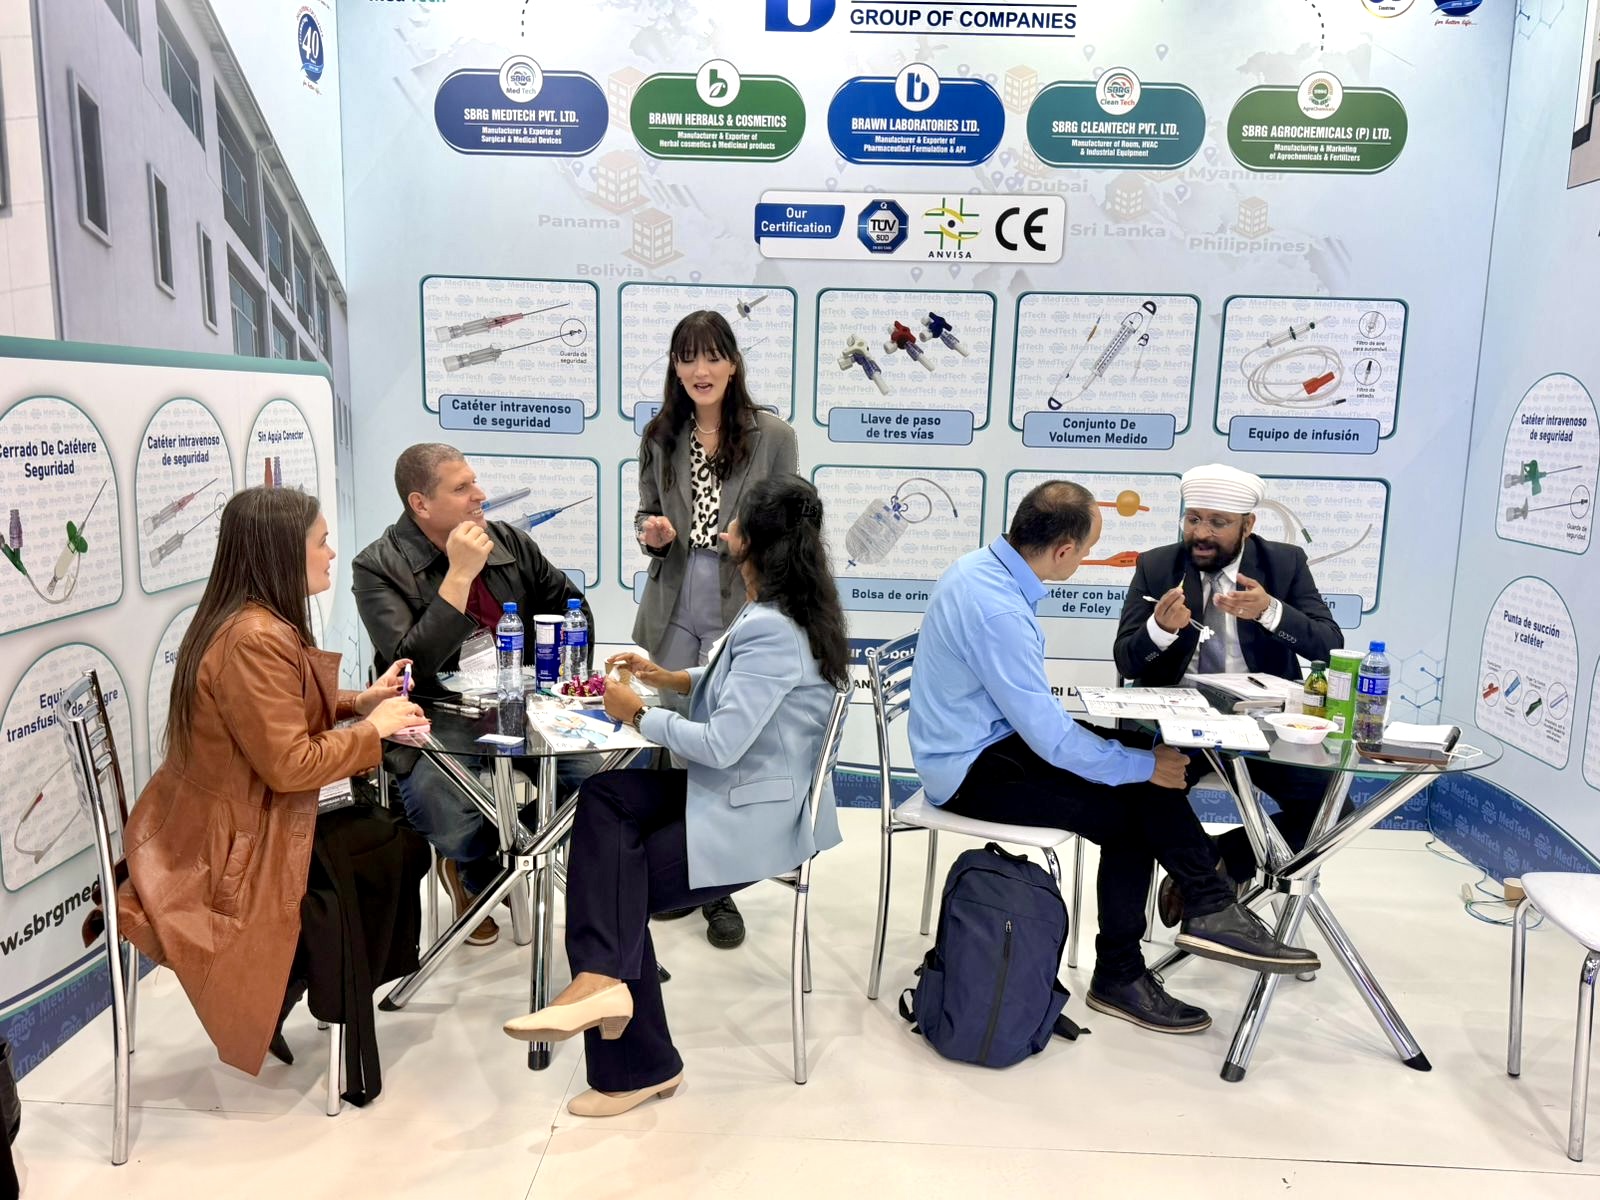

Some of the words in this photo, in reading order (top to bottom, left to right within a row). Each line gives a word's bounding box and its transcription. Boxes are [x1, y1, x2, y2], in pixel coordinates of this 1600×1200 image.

[850, 8, 921, 26] GROUP
[927, 10, 953, 27] OF
[960, 10, 1077, 29] COMPANIES
[302, 26, 320, 60] 40
[522, 87, 536, 95] Tech
[1106, 86, 1130, 94] SBRG
[1100, 98, 1119, 106] Clean
[464, 108, 489, 121] SBRG
[491, 109, 535, 122] MEDTECH
[538, 110, 557, 122] PVT.
[560, 111, 579, 123] LTD.
[649, 112, 683, 125] BRAWN
[684, 113, 724, 126] HERBALS
[726, 114, 733, 126] &
[735, 115, 787, 128] COSMETICS
[481, 126, 522, 135] Manufacturer
[523, 127, 528, 135] &
[529, 127, 553, 136] Exporter
[554, 128, 561, 136] of
[851, 117, 887, 130] BRAWN
[889, 118, 958, 132] LABORATORIES
[961, 120, 980, 132] LTD.
[1052, 121, 1078, 133] SBRG
[1080, 121, 1136, 135] CLEANTECH
[1138, 123, 1157, 135] PVT.
[1160, 123, 1180, 136] LTD.
[481, 135, 506, 144] Surgical
[513, 136, 537, 144] Medical
[538, 136, 562, 145] Devices
[677, 131, 718, 140] Manufacturer
[719, 132, 724, 140] &
[725, 132, 750, 141] Exporter
[751, 133, 758, 141] of
[875, 135, 915, 144] Manufacturer
[916, 136, 921, 144] &
[922, 136, 948, 145] Exporter
[949, 136, 956, 144] of
[1242, 125, 1268, 137] SBRG
[1270, 125, 1353, 139] AGROCHEMICALS
[1355, 127, 1369, 141] (P)
[1372, 128, 1392, 140] LTD.
[718, 141, 748, 149] Medicinal
[748, 142, 775, 151] products
[863, 144, 911, 153] Pharmaceutical
[912, 145, 948, 153] Formulation
[955, 146, 966, 154] API
[1071, 139, 1112, 148] Manufacturer
[1121, 140, 1141, 149] Room,
[1142, 140, 1158, 148] HVAC
[1274, 143, 1319, 153] Manufacturing
[1325, 145, 1357, 154] Marketing
[1080, 148, 1085, 156] &
[1116, 149, 1149, 158] Equipment
[1277, 153, 1322, 162] Agrochemicals
[1329, 154, 1361, 162] Fertilizers
[1027, 179, 1088, 193] Dubai
[786, 207, 808, 219] Our
[538, 214, 620, 229] Panama
[760, 220, 832, 233] Certification
[870, 219, 897, 231] TÜV
[995, 207, 1048, 251] CE
[1070, 224, 1097, 237] Sri
[1104, 224, 1166, 238] Lanka
[1189, 237, 1306, 254] Philippines
[928, 250, 972, 259] ANVISA
[576, 263, 644, 278] Bolivia
[452, 398, 497, 412] Catéter
[500, 400, 571, 414] intravenoso
[473, 414, 487, 426] de
[491, 416, 551, 430] seguridad
[861, 413, 892, 424] Llave
[895, 414, 909, 425] de
[912, 416, 941, 428] paso
[1062, 417, 1116, 432] Conjunto
[1120, 418, 1136, 430] De
[1521, 411, 1545, 426] Catéter
[1545, 413, 1587, 428] intravenoso
[257, 431, 267, 443] Sin
[267, 431, 283, 444] Aguja
[283, 429, 304, 442] Conector
[866, 427, 880, 438] de
[883, 429, 907, 439] tres
[910, 427, 934, 439] vías
[1049, 431, 1102, 443] Volumen
[1104, 432, 1148, 444] Medido
[1248, 427, 1290, 442] Equipo
[1293, 428, 1308, 440] de
[1311, 428, 1360, 441] infusión
[1529, 430, 1538, 441] de
[1539, 430, 1573, 444] seguridad
[41, 440, 55, 456] De
[57, 438, 97, 455] Catétere
[147, 435, 177, 451] Catéter
[178, 433, 220, 450] intravenoso
[162, 452, 173, 466] de
[174, 450, 210, 468] seguridad
[24, 459, 75, 480] Seguridad
[852, 588, 884, 600] Bolsa
[888, 590, 901, 600] de
[905, 590, 930, 601] orin
[1048, 587, 1079, 599] téter
[1082, 591, 1103, 600] con
[1107, 590, 1128, 600] bal
[1062, 602, 1076, 612] de
[1079, 603, 1111, 616] Foley
[1503, 609, 1522, 626] Punta
[1523, 616, 1532, 629] de
[1533, 621, 1560, 639] succión
[1514, 631, 1519, 643] y
[1520, 631, 1545, 649] catéter
[7, 711, 61, 743] transfusi
